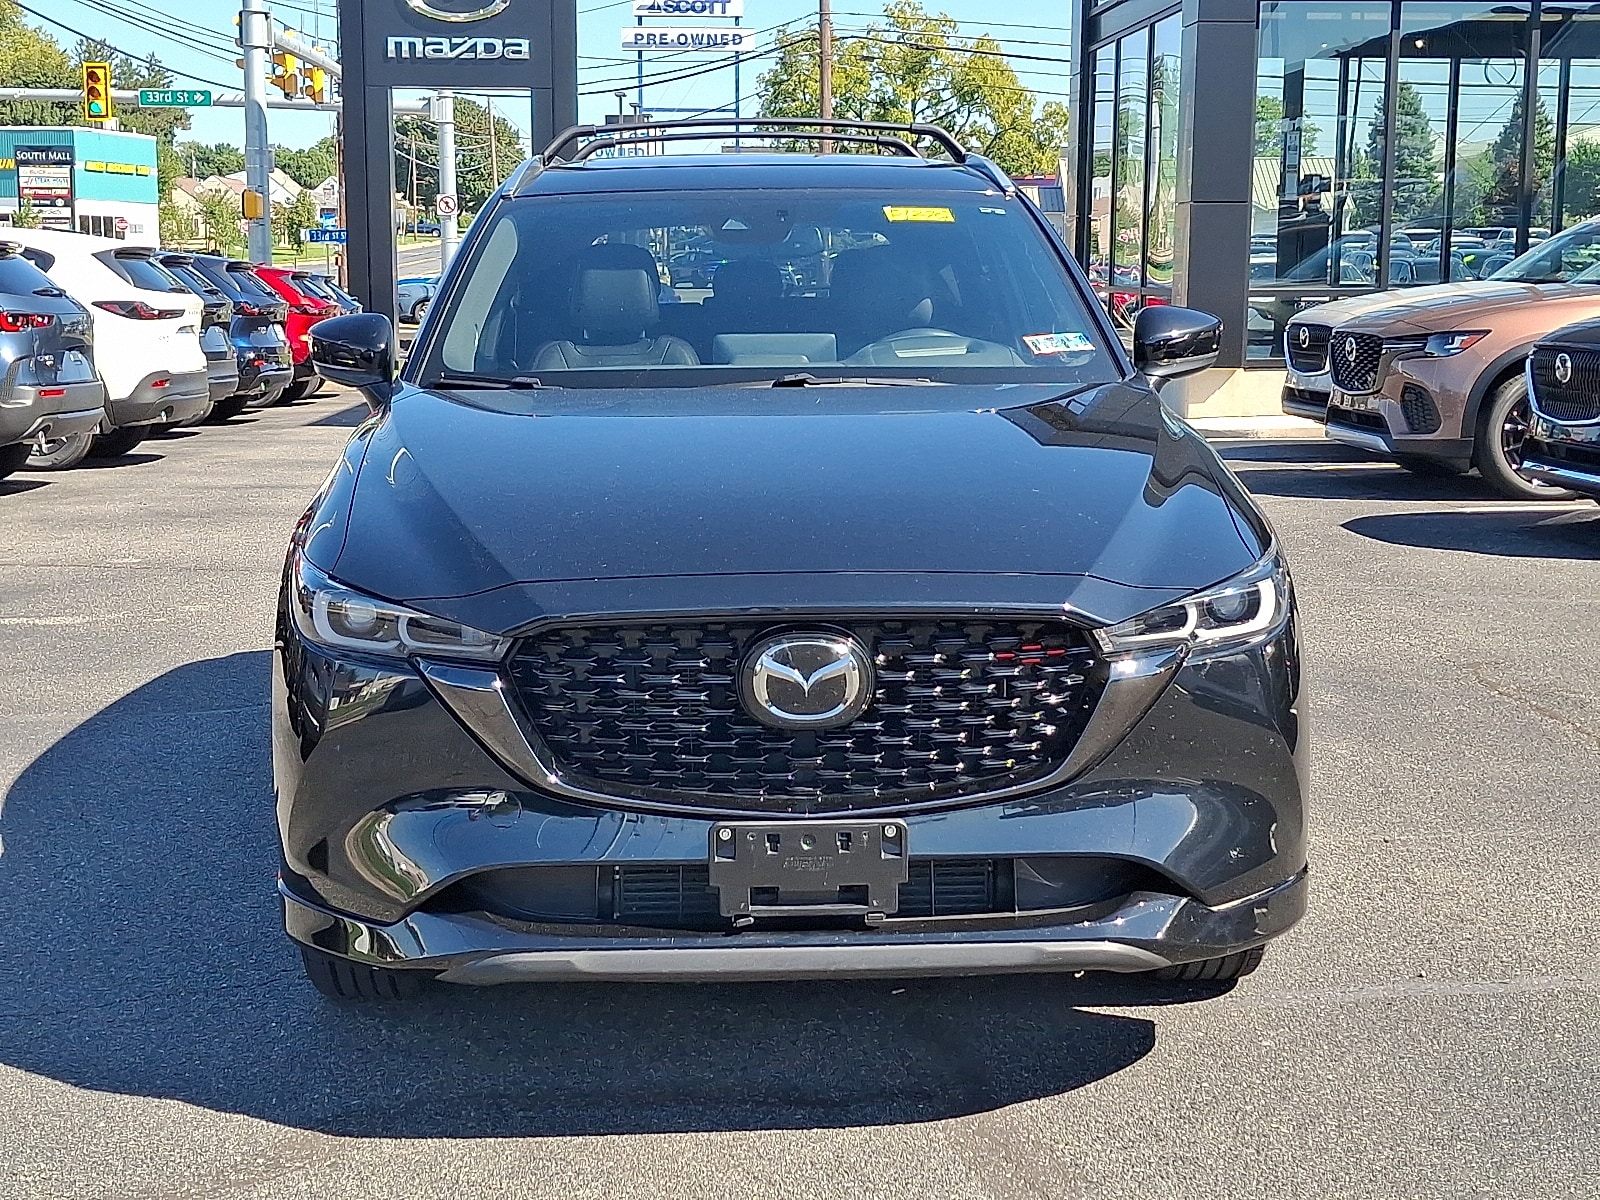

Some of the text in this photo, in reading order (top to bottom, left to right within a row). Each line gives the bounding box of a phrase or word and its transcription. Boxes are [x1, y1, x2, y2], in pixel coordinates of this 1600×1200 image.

[662, 0, 731, 14] SCOTT
[146, 91, 189, 103] 33rd St
[16, 151, 72, 160] SOUTH MALL
[311, 231, 330, 240] 33rd
